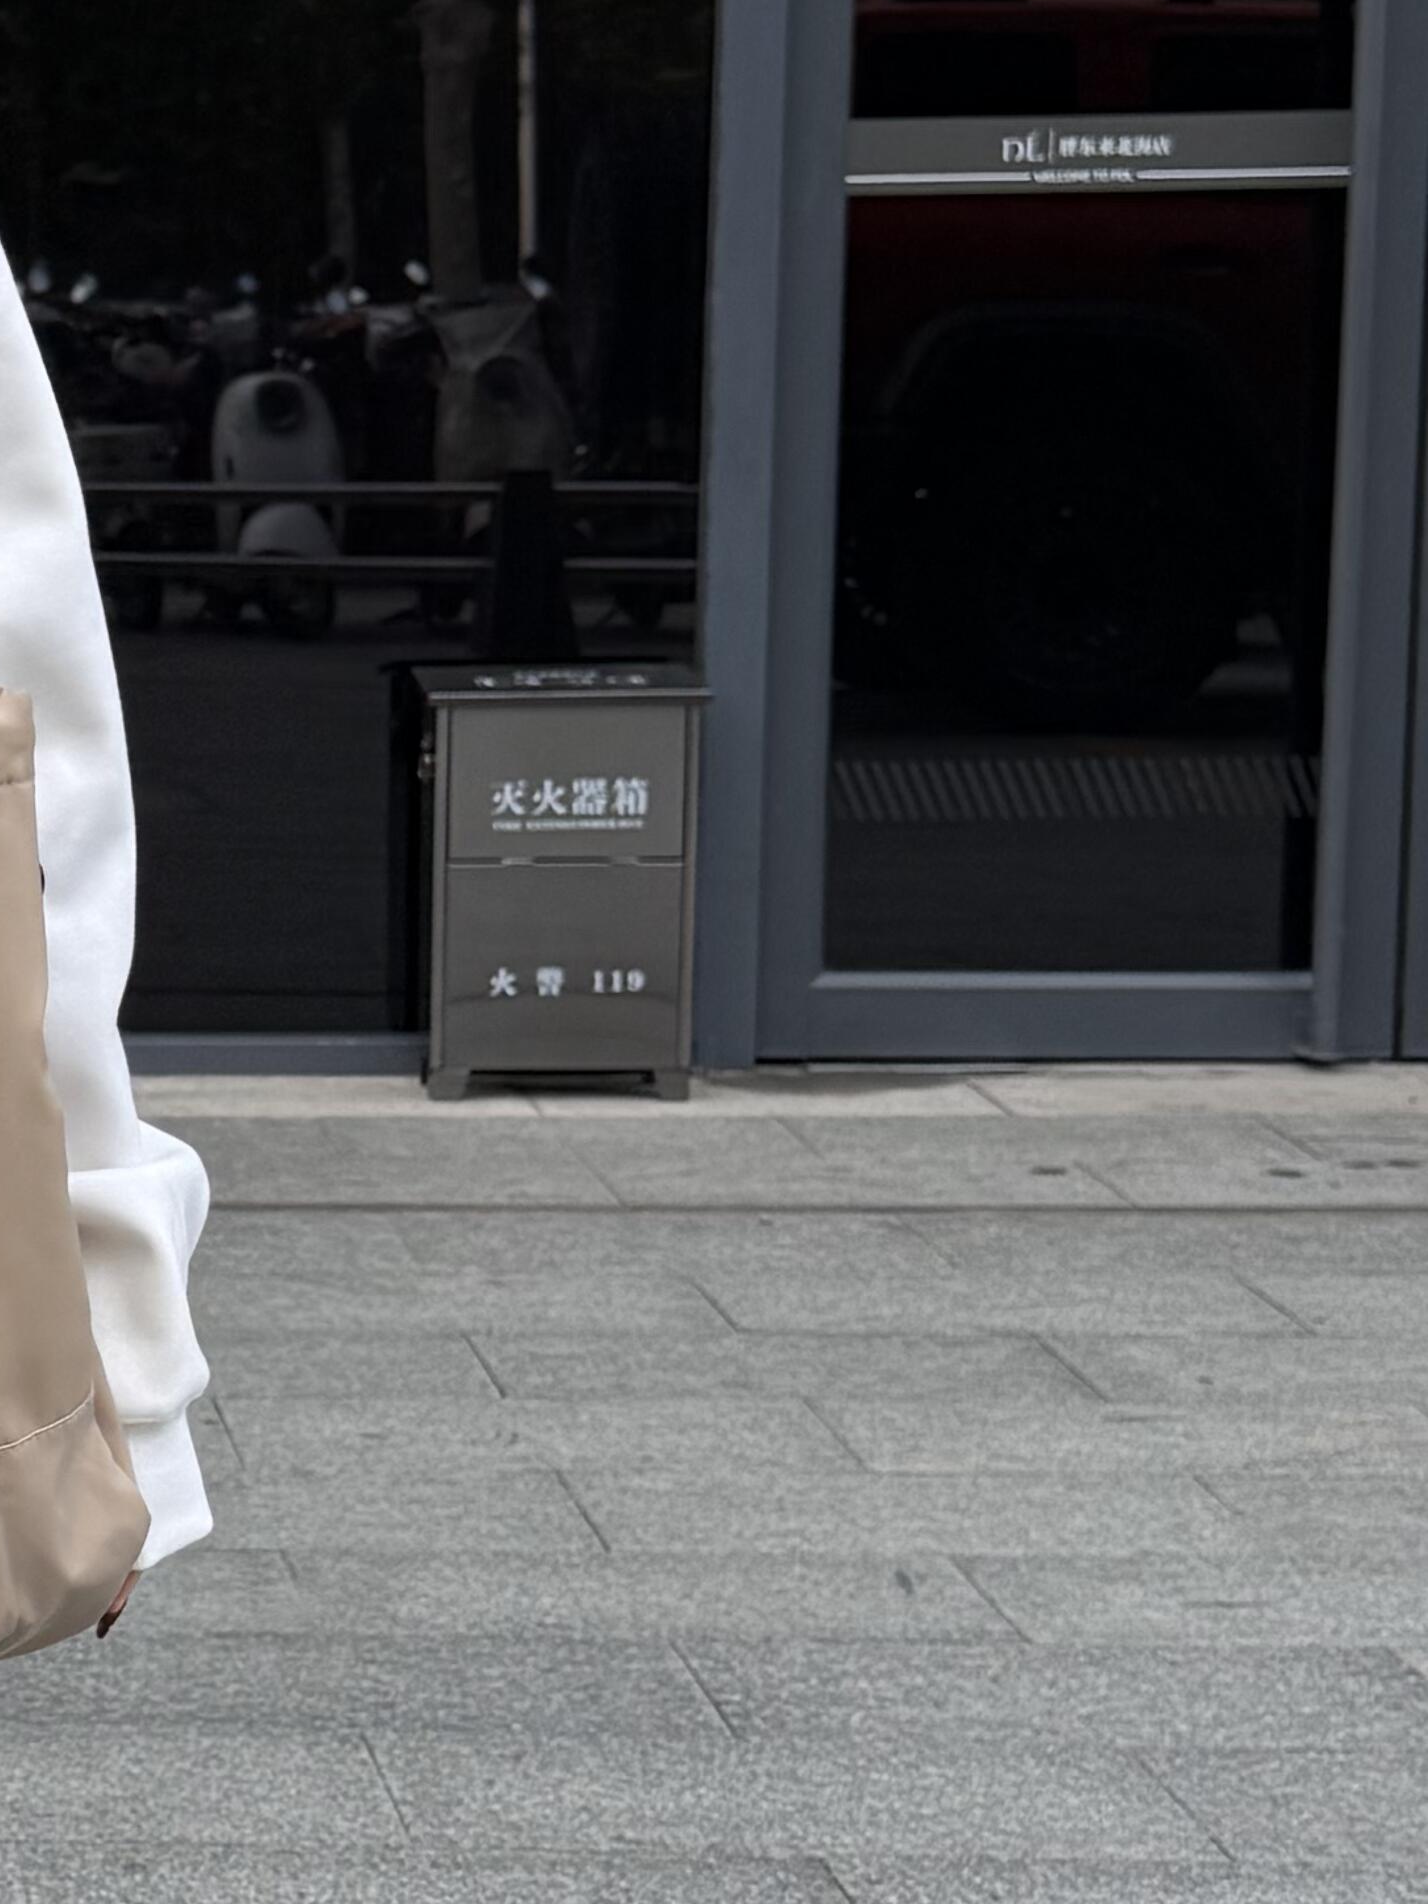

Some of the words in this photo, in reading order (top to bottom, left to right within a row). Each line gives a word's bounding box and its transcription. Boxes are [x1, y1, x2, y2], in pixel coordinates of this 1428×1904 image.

[491, 777, 649, 816] 灭火器箱
[593, 968, 645, 994] 119
